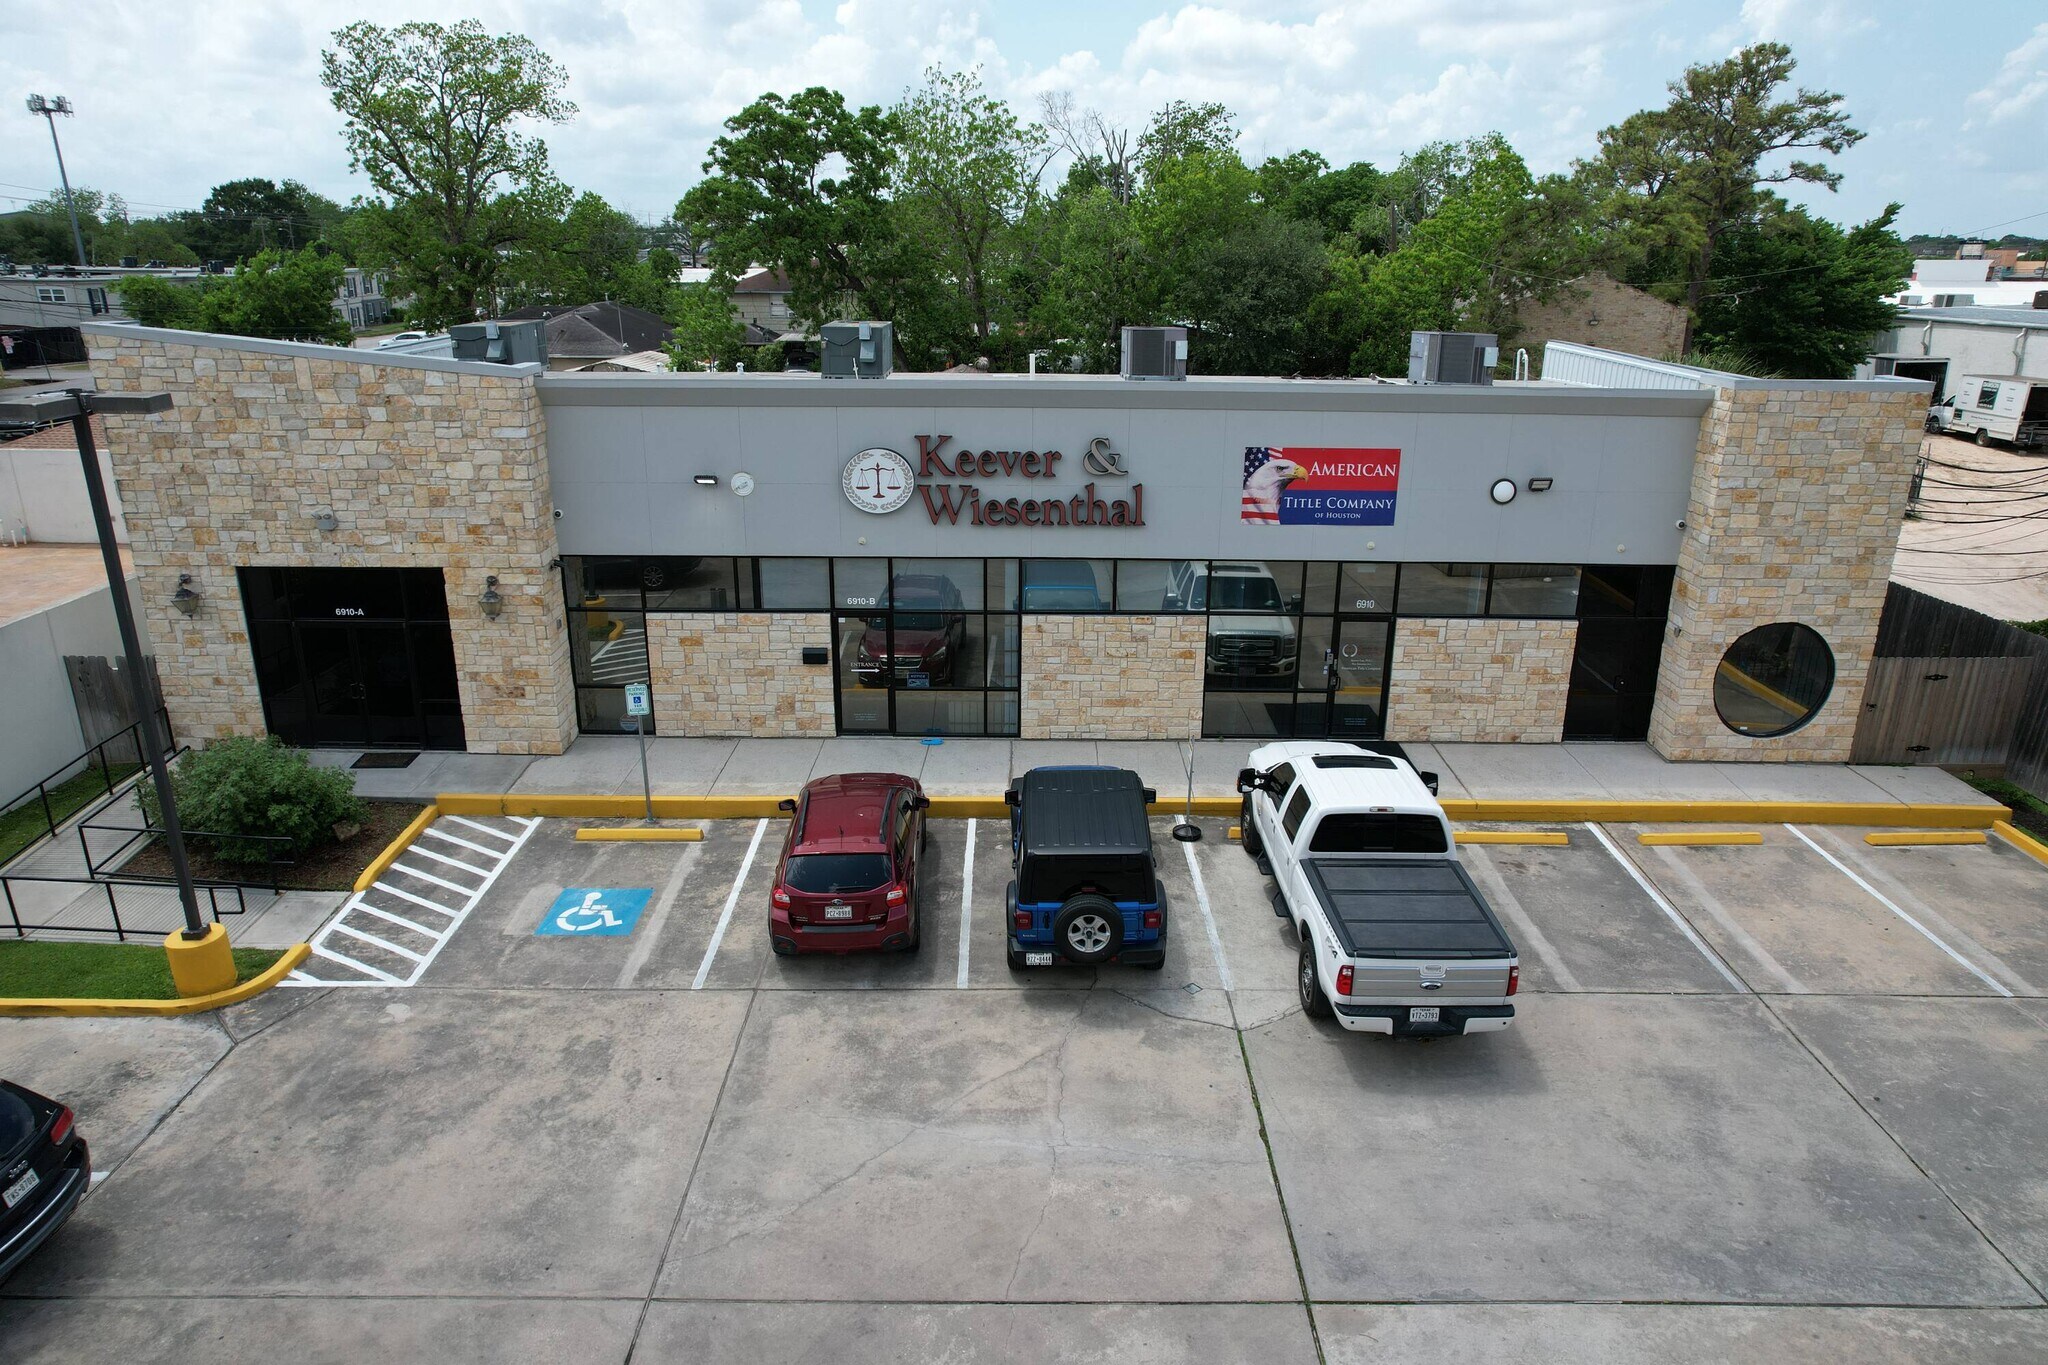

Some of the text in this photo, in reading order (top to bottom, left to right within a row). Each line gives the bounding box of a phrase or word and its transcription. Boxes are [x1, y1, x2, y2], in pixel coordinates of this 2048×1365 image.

[914, 434, 1129, 478] Keever &
[1309, 461, 1397, 477] AMERICAN
[917, 482, 1147, 527] Wiesenthal
[1284, 497, 1394, 510] TITLE COMPANY
[847, 597, 876, 605] 6910-B
[1356, 599, 1375, 609] 6910
[335, 608, 365, 616] 6910-A
